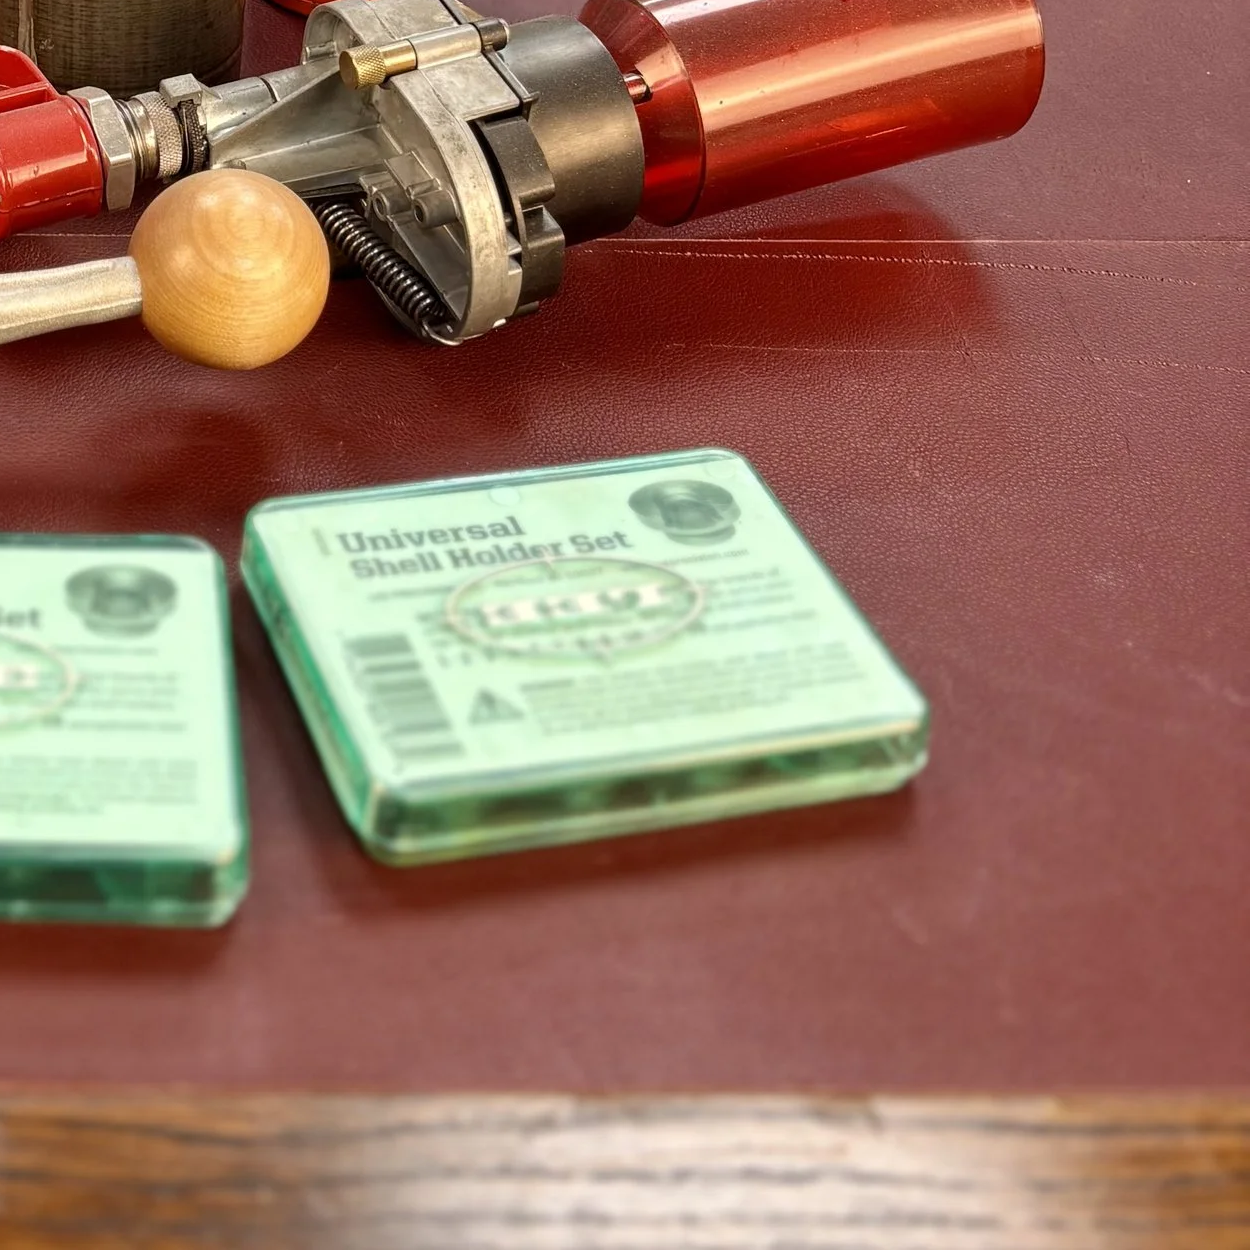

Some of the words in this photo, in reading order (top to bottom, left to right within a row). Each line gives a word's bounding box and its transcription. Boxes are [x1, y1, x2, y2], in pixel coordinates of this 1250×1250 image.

[336, 516, 527, 554] Universal
[350, 551, 443, 579] Shell
[450, 540, 565, 568] Holder
[569, 530, 634, 551] Set
